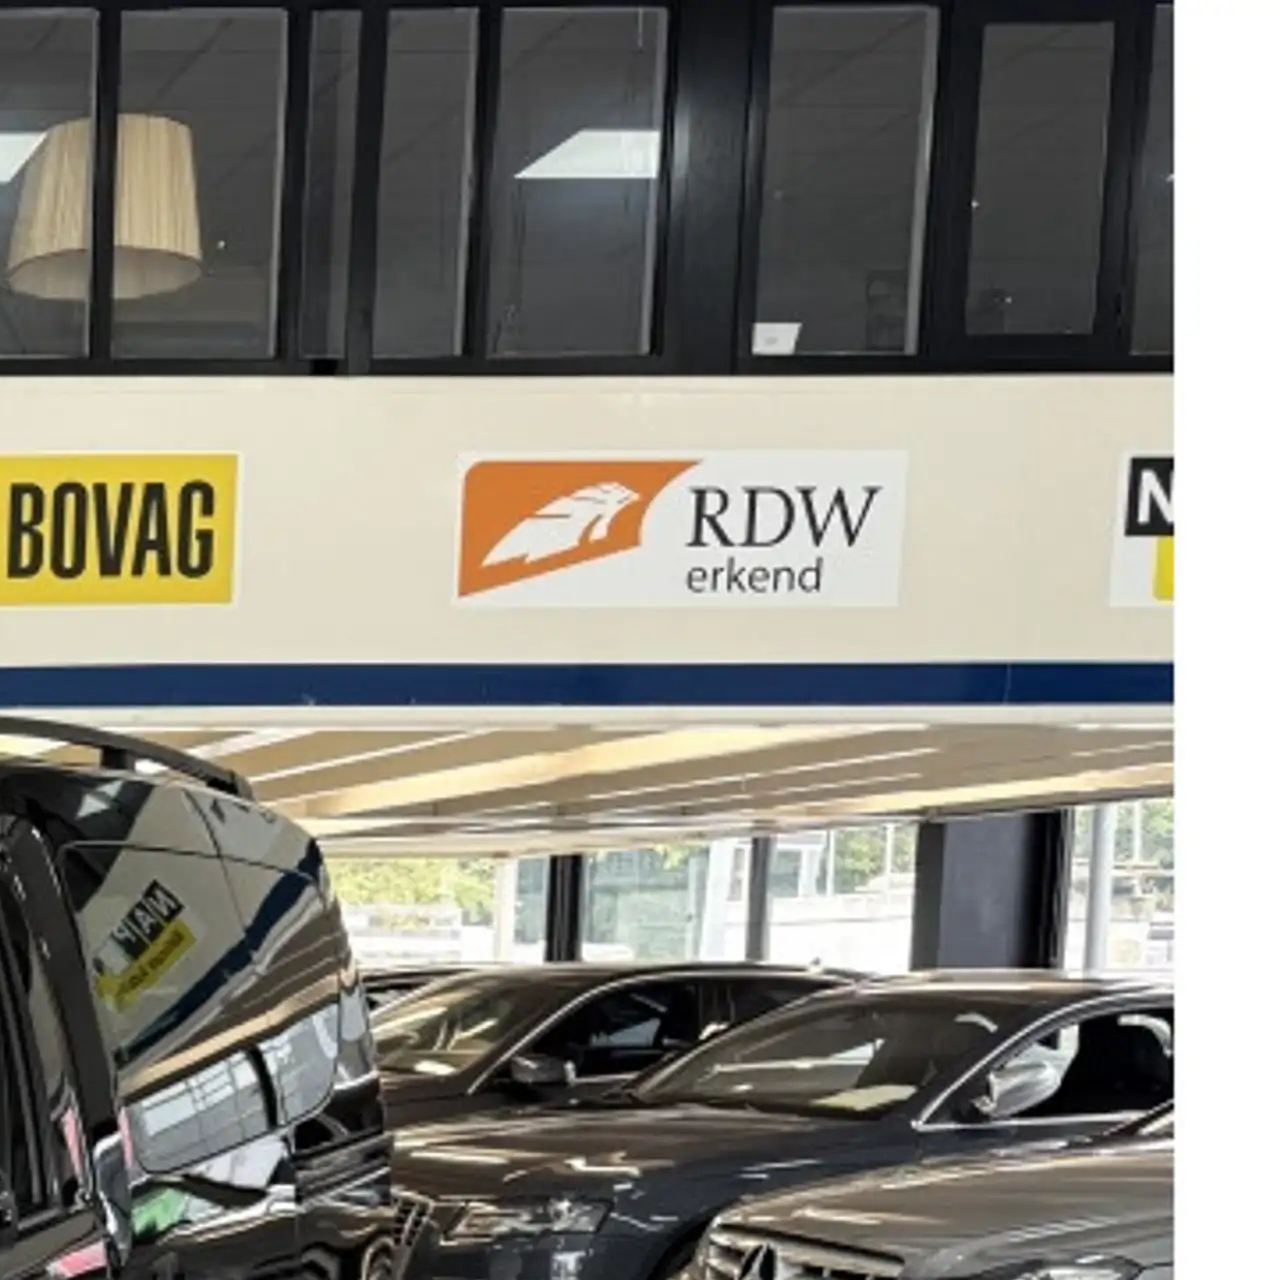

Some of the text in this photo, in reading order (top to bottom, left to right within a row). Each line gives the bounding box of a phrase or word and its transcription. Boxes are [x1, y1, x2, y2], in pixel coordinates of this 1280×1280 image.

[7, 480, 215, 579] BOVAG
[685, 485, 884, 547] RDW
[686, 556, 824, 593] erkend
